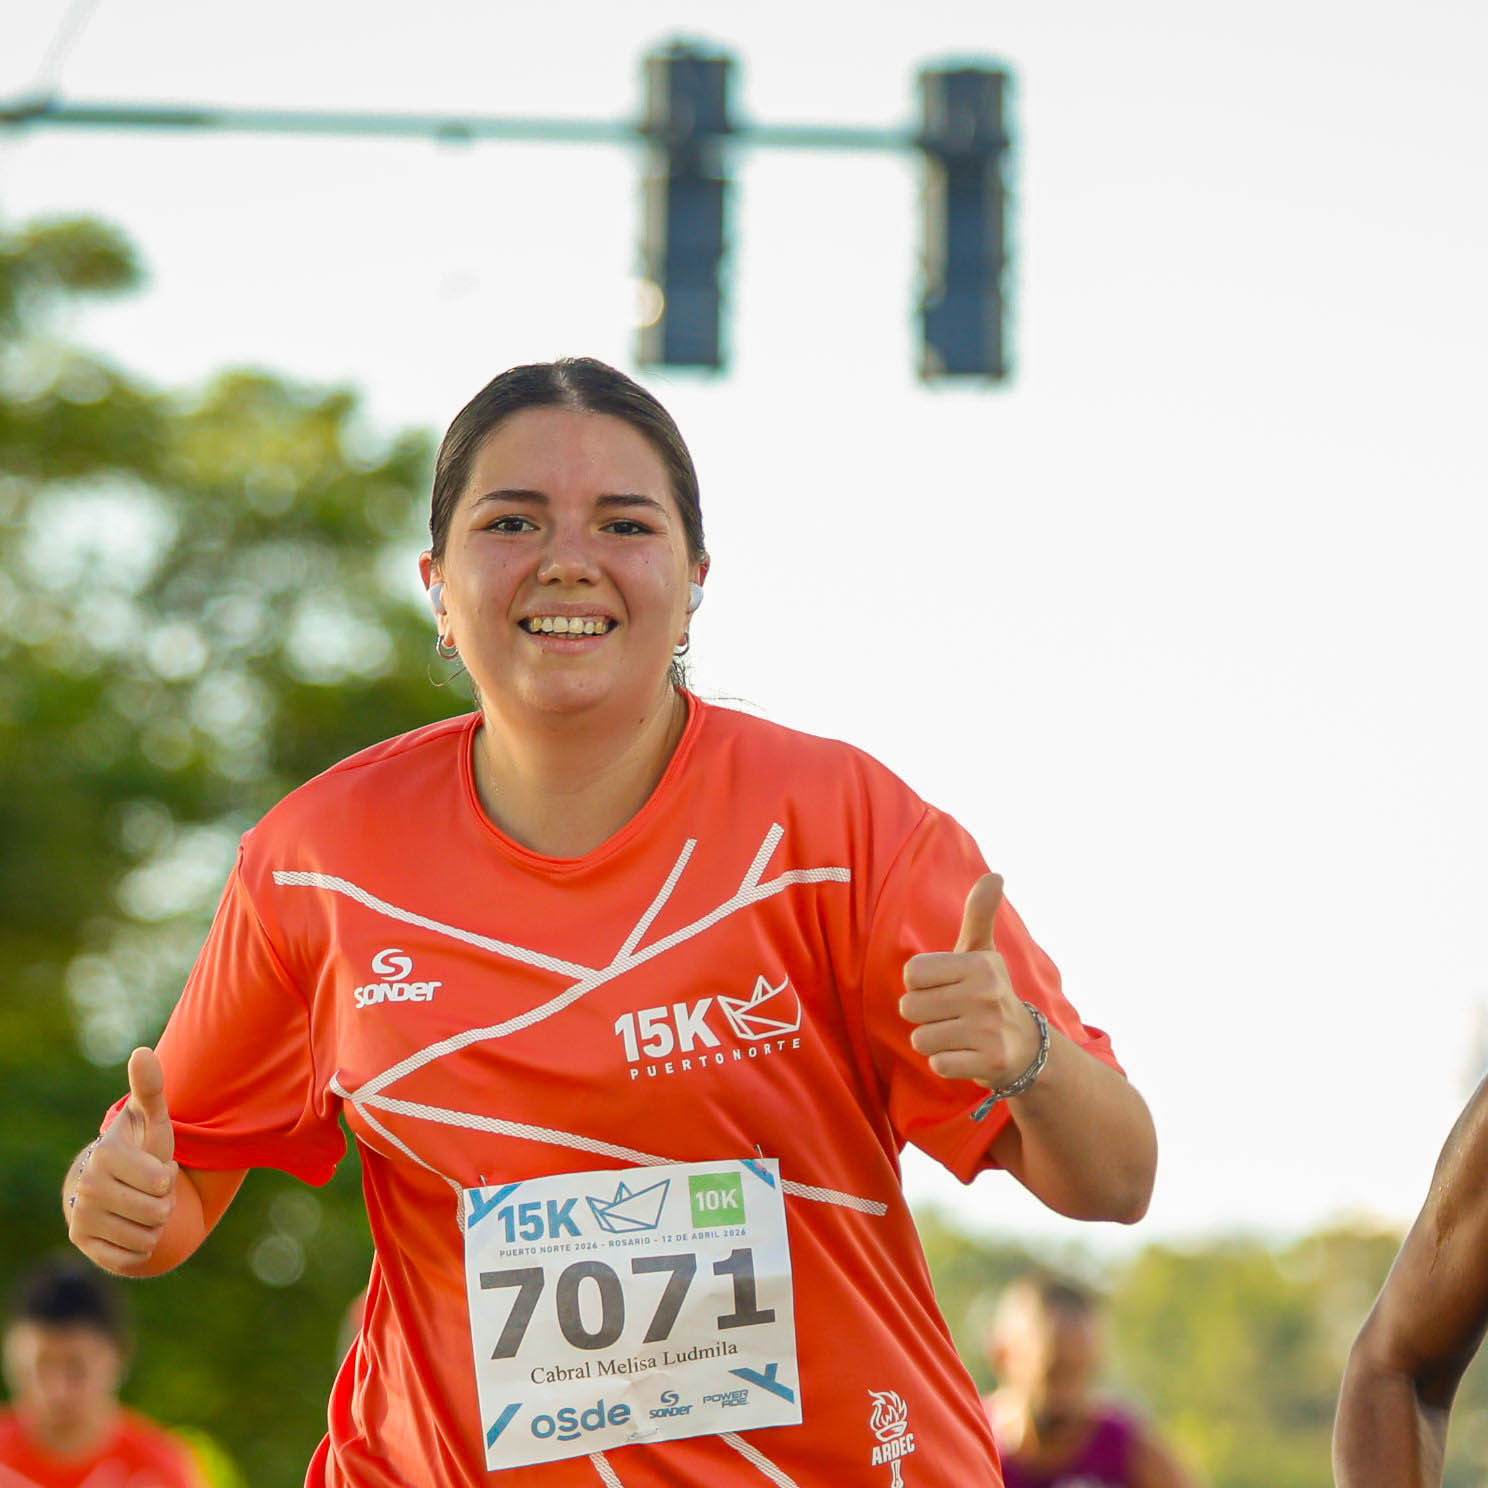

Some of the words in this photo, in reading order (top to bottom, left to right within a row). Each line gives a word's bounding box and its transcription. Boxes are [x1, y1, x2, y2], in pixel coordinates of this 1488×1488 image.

[614, 997, 722, 1063] 15K
[498, 1197, 583, 1244] 15K
[695, 1189, 739, 1212] 10K
[499, 1247, 537, 1257] PUERTO
[540, 1243, 571, 1254] NORTE
[575, 1241, 598, 1251] 2026
[608, 1236, 651, 1247] ROSARIO
[662, 1235, 673, 1243] 12
[676, 1233, 689, 1241] DE
[692, 1230, 720, 1240] ABRIL
[723, 1228, 747, 1237] 2026
[479, 1247, 776, 1361] 7071
[530, 1361, 591, 1385] Cabral
[597, 1356, 657, 1377] Melisa
[663, 1341, 738, 1366] Ludmila
[530, 1398, 632, 1441] osde
[872, 1433, 915, 1466] ARDEC
